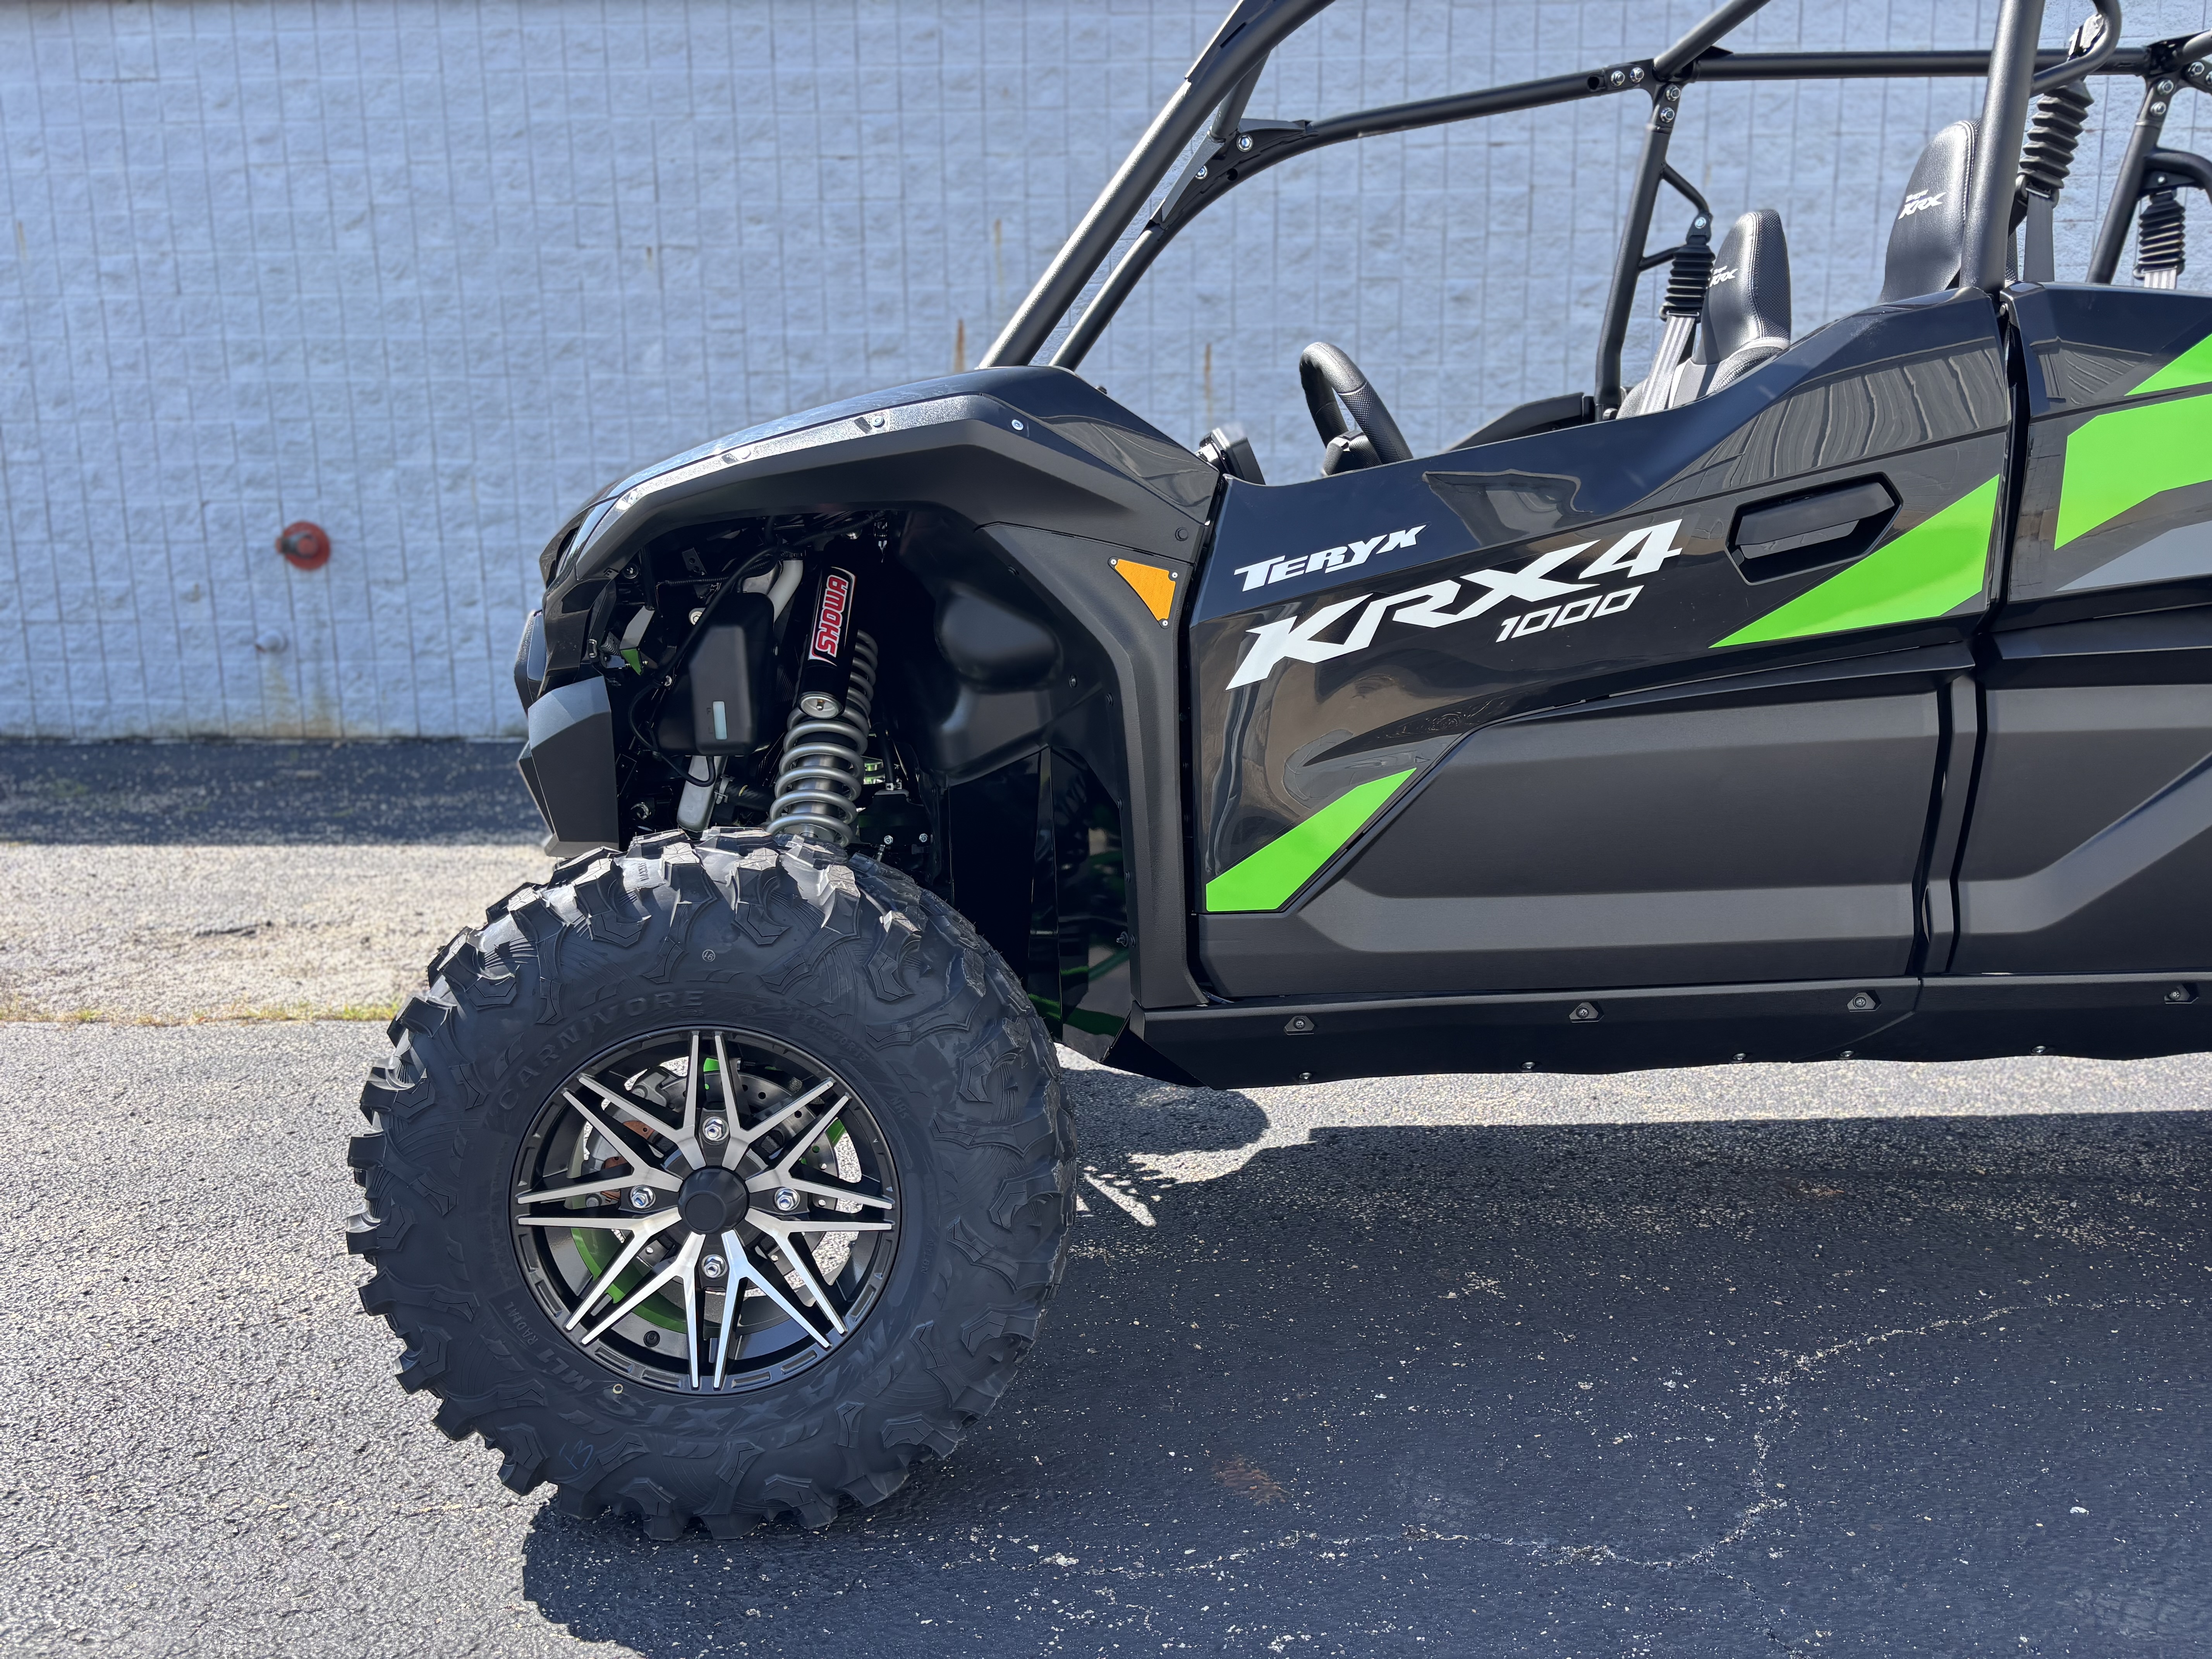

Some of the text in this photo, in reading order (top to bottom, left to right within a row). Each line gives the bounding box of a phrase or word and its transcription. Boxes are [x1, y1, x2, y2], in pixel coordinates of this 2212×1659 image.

[1234, 524, 1427, 592] TERYX
[815, 574, 849, 658] SHOWA
[1225, 519, 1683, 690] KRX4
[1496, 585, 1644, 643] 1000
[499, 989, 704, 1110] CARNIVORE
[891, 1096, 910, 1120] NHS
[921, 1238, 934, 1274] NYLON
[504, 1301, 888, 1431] MAXXIS ML1 RADIAL
